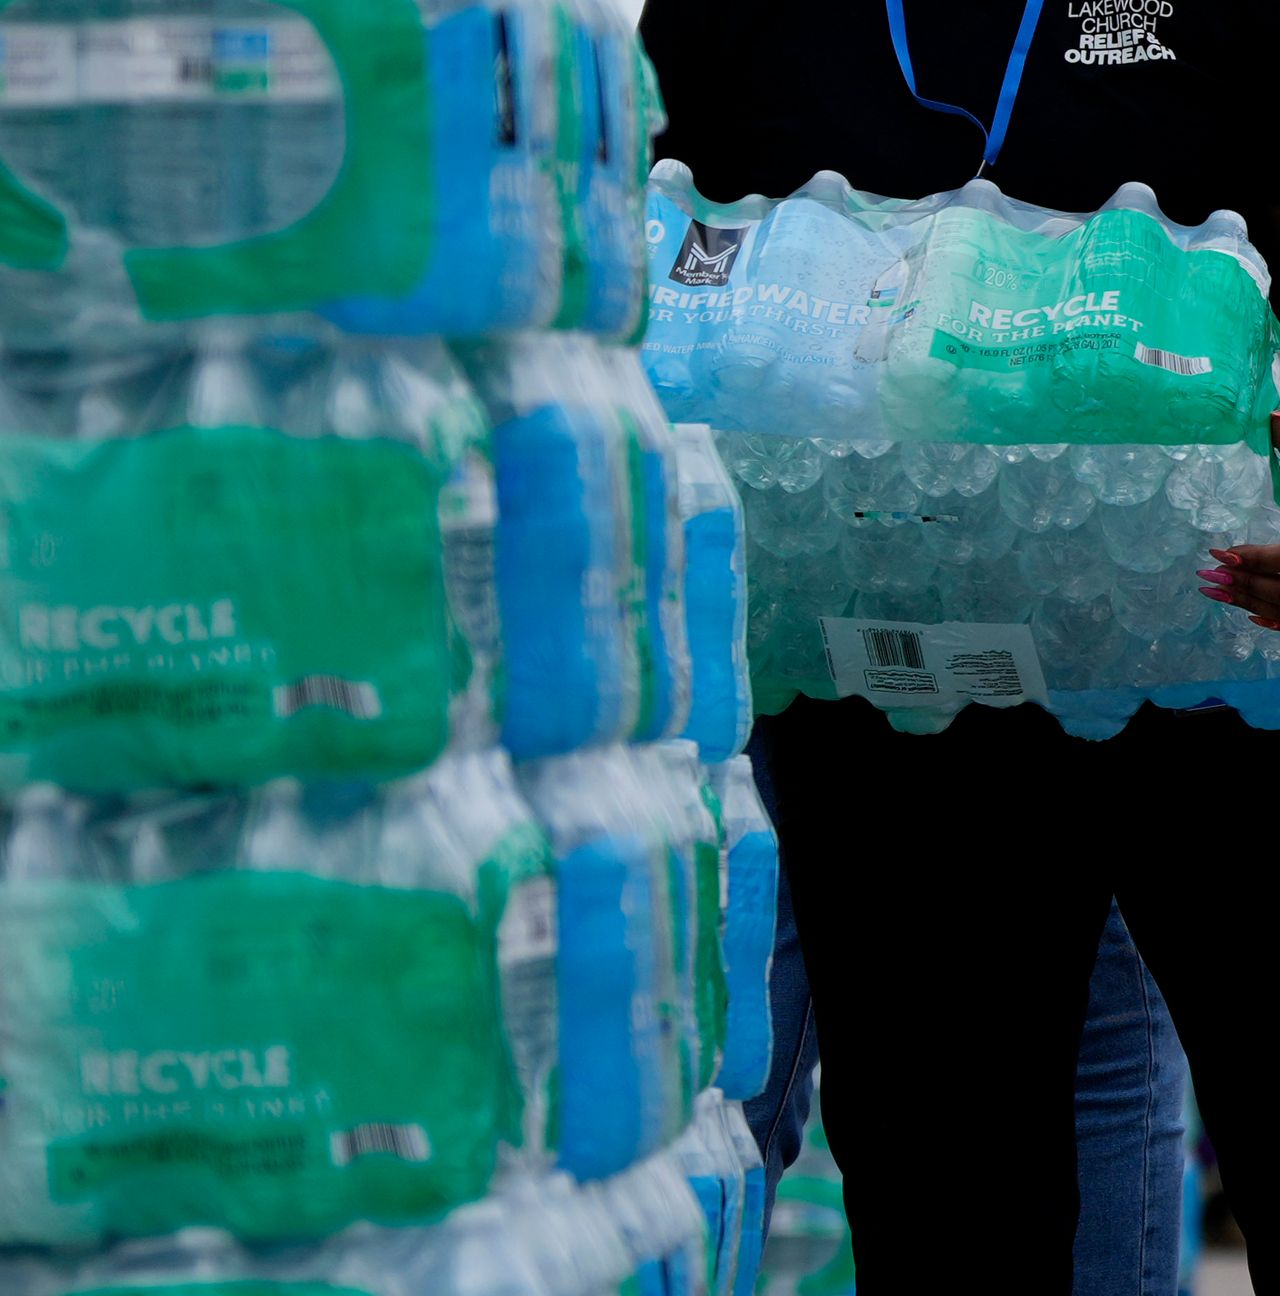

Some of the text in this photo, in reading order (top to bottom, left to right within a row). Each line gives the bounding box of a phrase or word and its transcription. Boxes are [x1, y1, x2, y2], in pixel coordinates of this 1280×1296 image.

[1081, 11, 1157, 34] CHURCH
[1079, 29, 1145, 49] RELIEF
[1064, 44, 1177, 65] OUTREACH
[675, 266, 729, 280] Member's
[685, 276, 713, 285] Mark
[984, 266, 1017, 290] 20%
[649, 283, 872, 325] RIFIED WATER
[969, 290, 1121, 330] RECYCLE
[750, 304, 841, 339] THIRST
[936, 313, 1144, 343] FOR THE PLANET
[979, 349, 1000, 357] 16.9
[1010, 356, 1026, 366] NET
[20, 598, 236, 651] RECYCLE
[79, 1044, 289, 1096] RECYCLE
